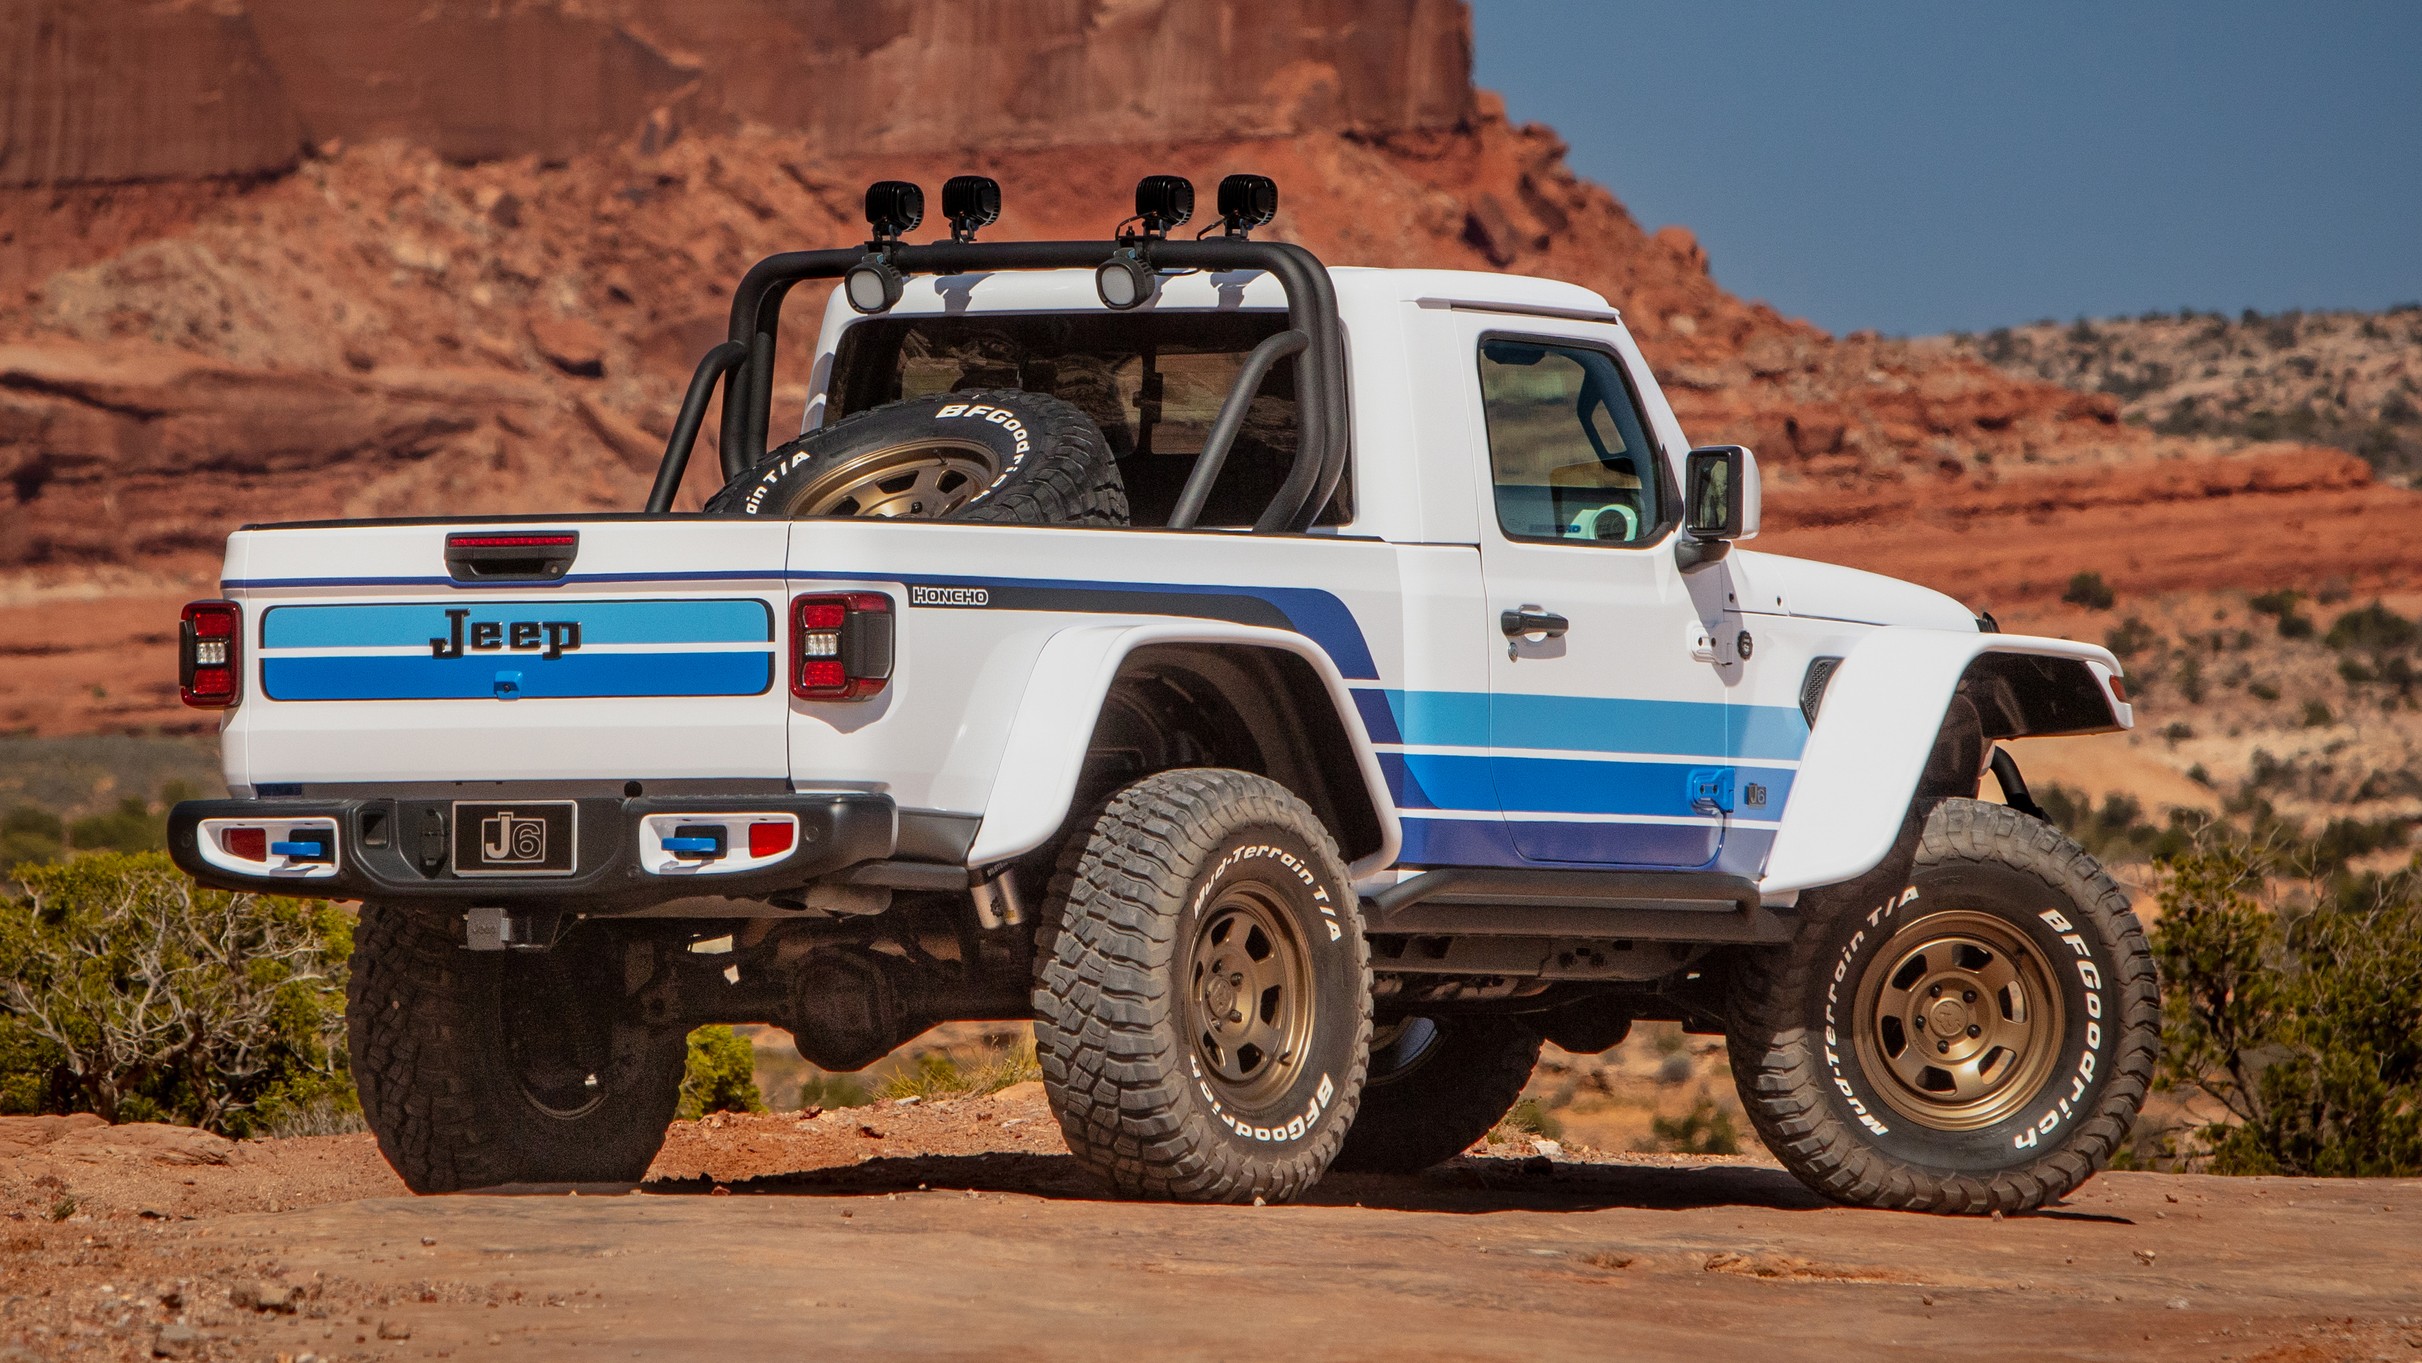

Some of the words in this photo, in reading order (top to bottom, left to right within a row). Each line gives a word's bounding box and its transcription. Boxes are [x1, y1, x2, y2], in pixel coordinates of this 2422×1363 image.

[762, 450, 811, 484] T/A
[912, 586, 989, 606] HONCHO
[428, 606, 583, 661] Jeep
[485, 814, 542, 860] J6
[1193, 845, 1315, 920] Mud-Terrain
[1312, 884, 1343, 943] T/A
[1824, 929, 1890, 1137] Mud-Terrain
[1866, 885, 1920, 928] T/A
[2013, 908, 2103, 1150] BFGoodrich
[1189, 1053, 1335, 1142] BFGoodrich
